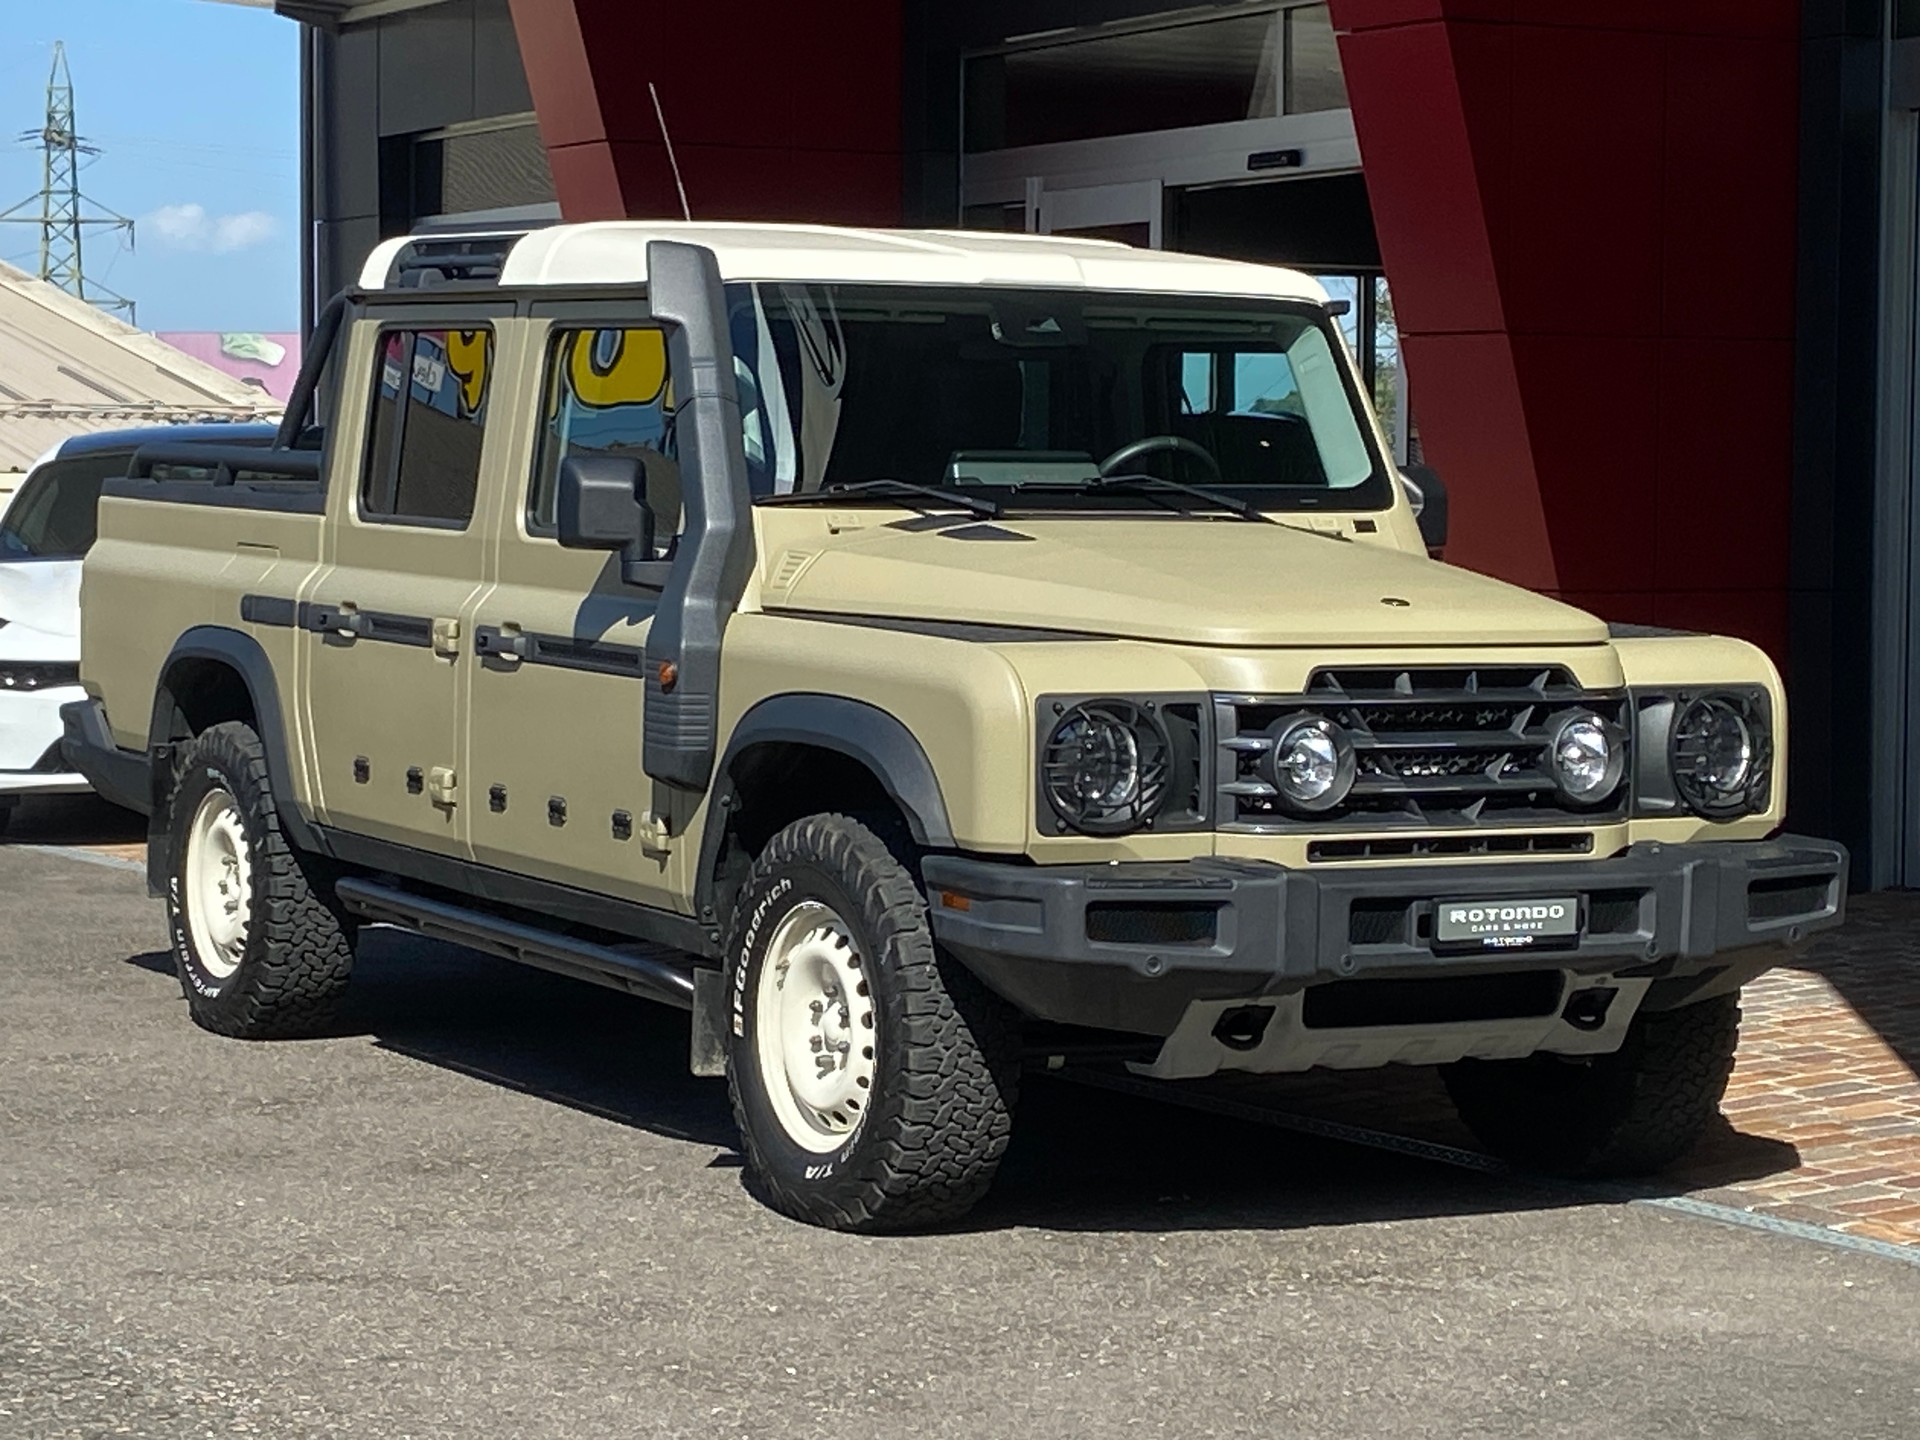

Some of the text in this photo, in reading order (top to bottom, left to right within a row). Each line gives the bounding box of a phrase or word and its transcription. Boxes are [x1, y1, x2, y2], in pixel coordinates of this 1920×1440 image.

[1450, 905, 1565, 923] ROTONDO
[1471, 924, 1498, 932] CARS
[804, 1162, 834, 1180] T/A
